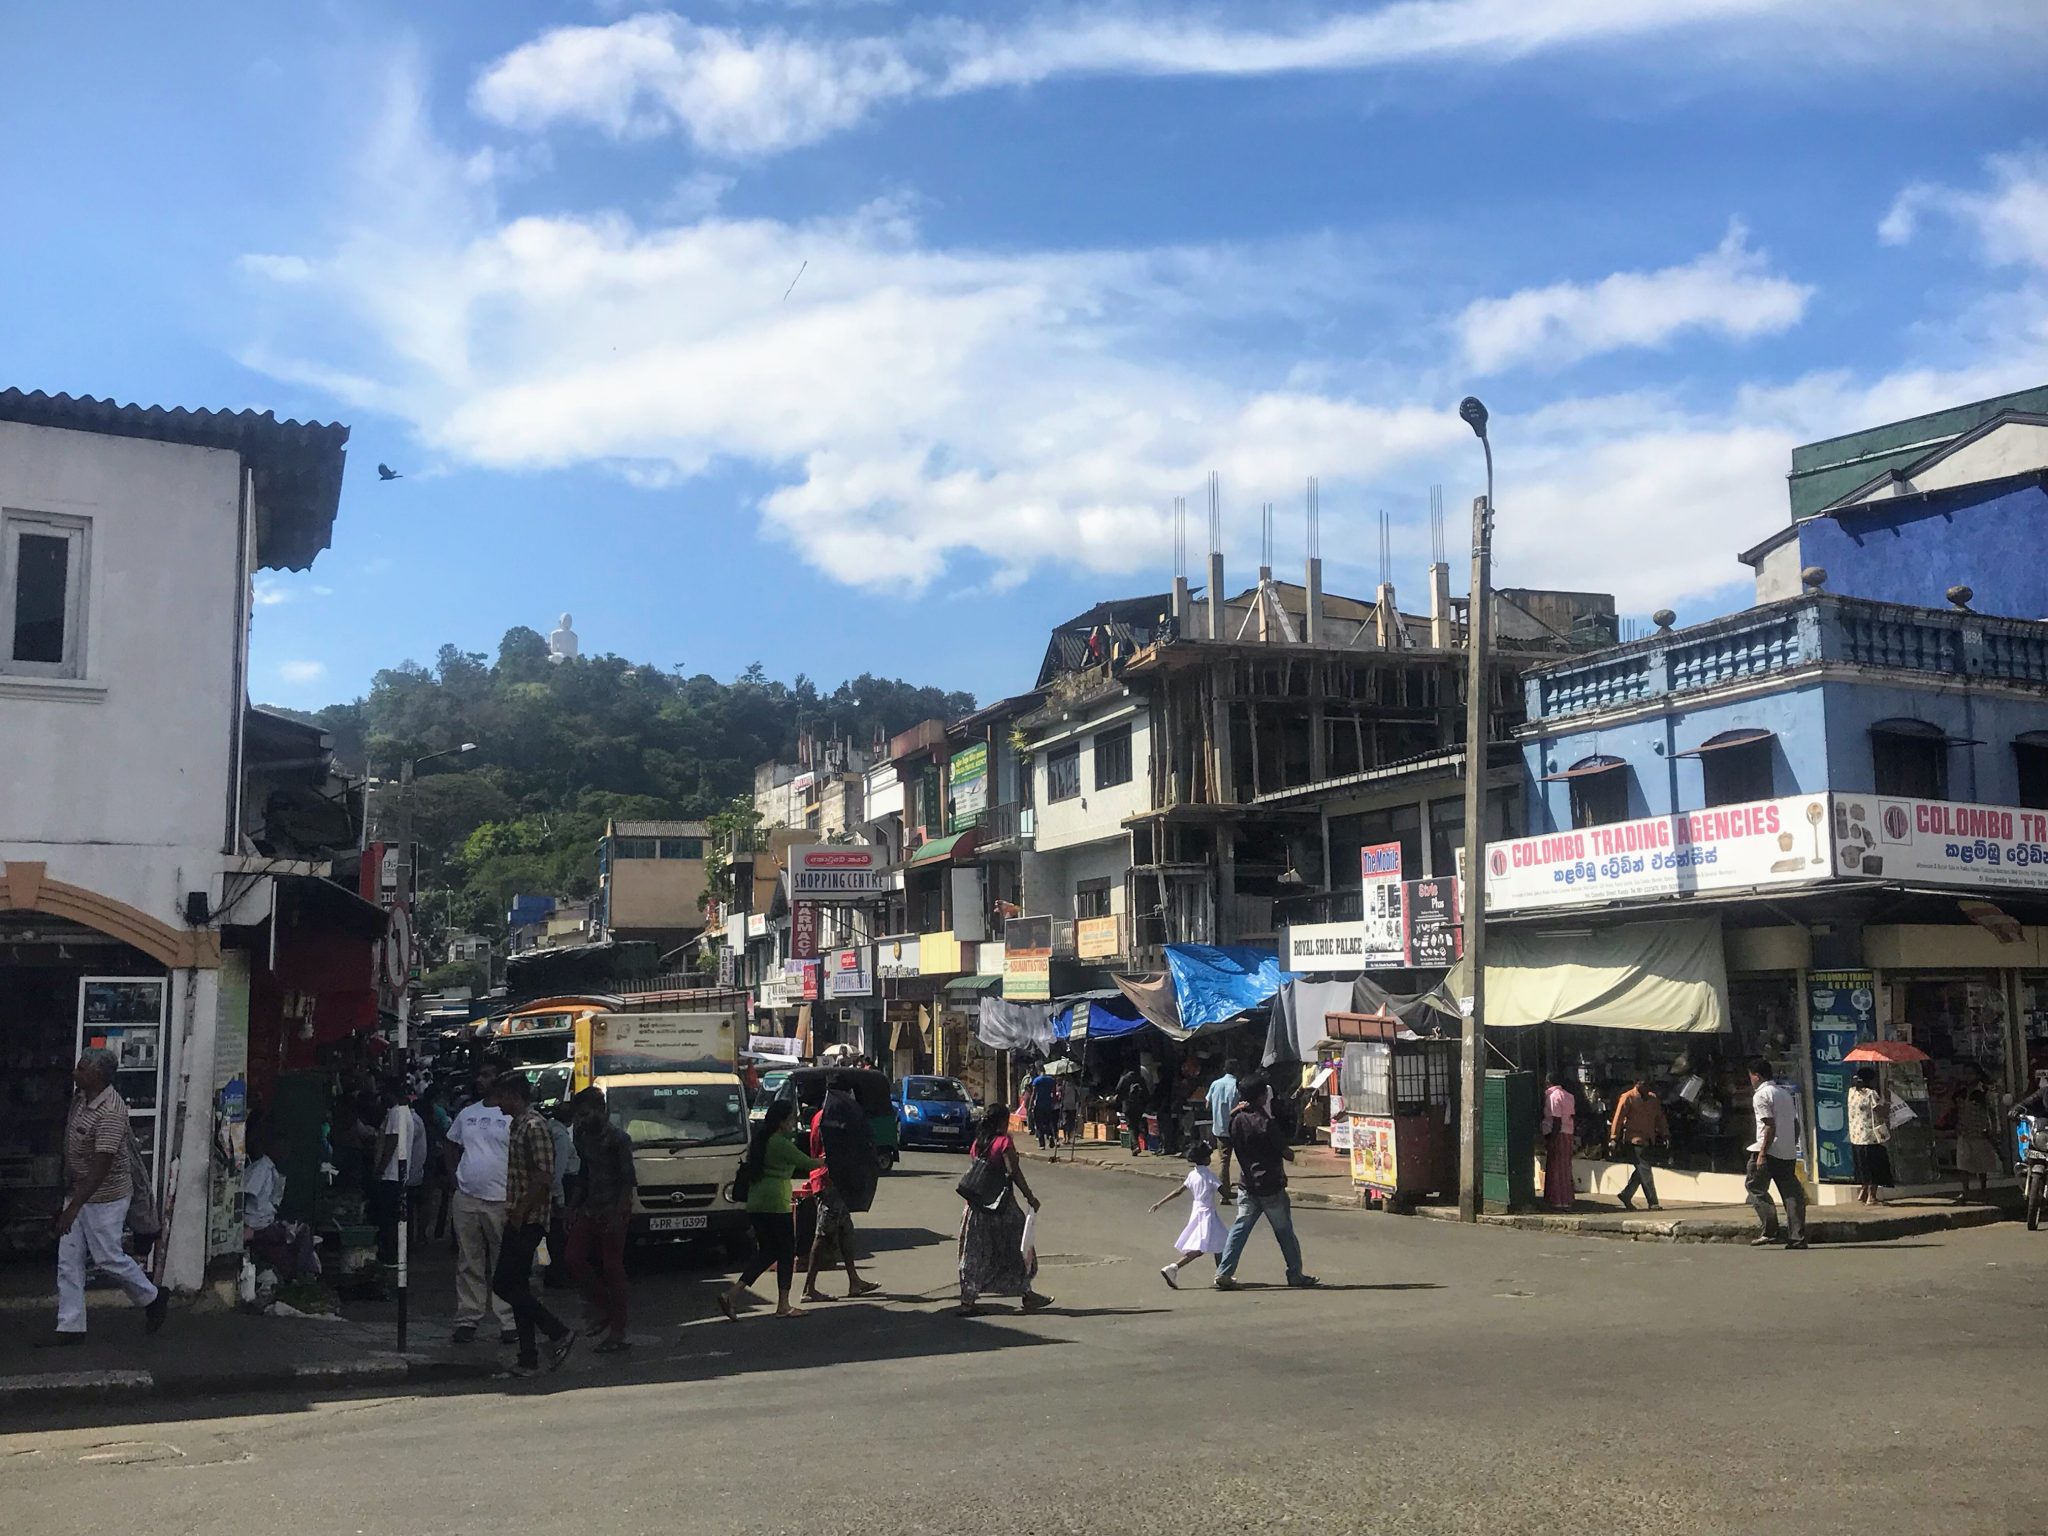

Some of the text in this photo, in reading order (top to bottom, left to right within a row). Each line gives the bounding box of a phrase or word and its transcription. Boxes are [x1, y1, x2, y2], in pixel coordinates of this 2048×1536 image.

[1916, 804, 2014, 840] COLOMBO
[1512, 805, 1780, 868] COLOMBO TRADING AGENCIES
[1363, 847, 1399, 873] The Mobile
[795, 872, 883, 888] SHOPPING CENTRE
[1431, 898, 1445, 909] Plus
[1294, 937, 1363, 957] ROYAL SHOE PALACE
[1816, 973, 1847, 981] COLOMBO
